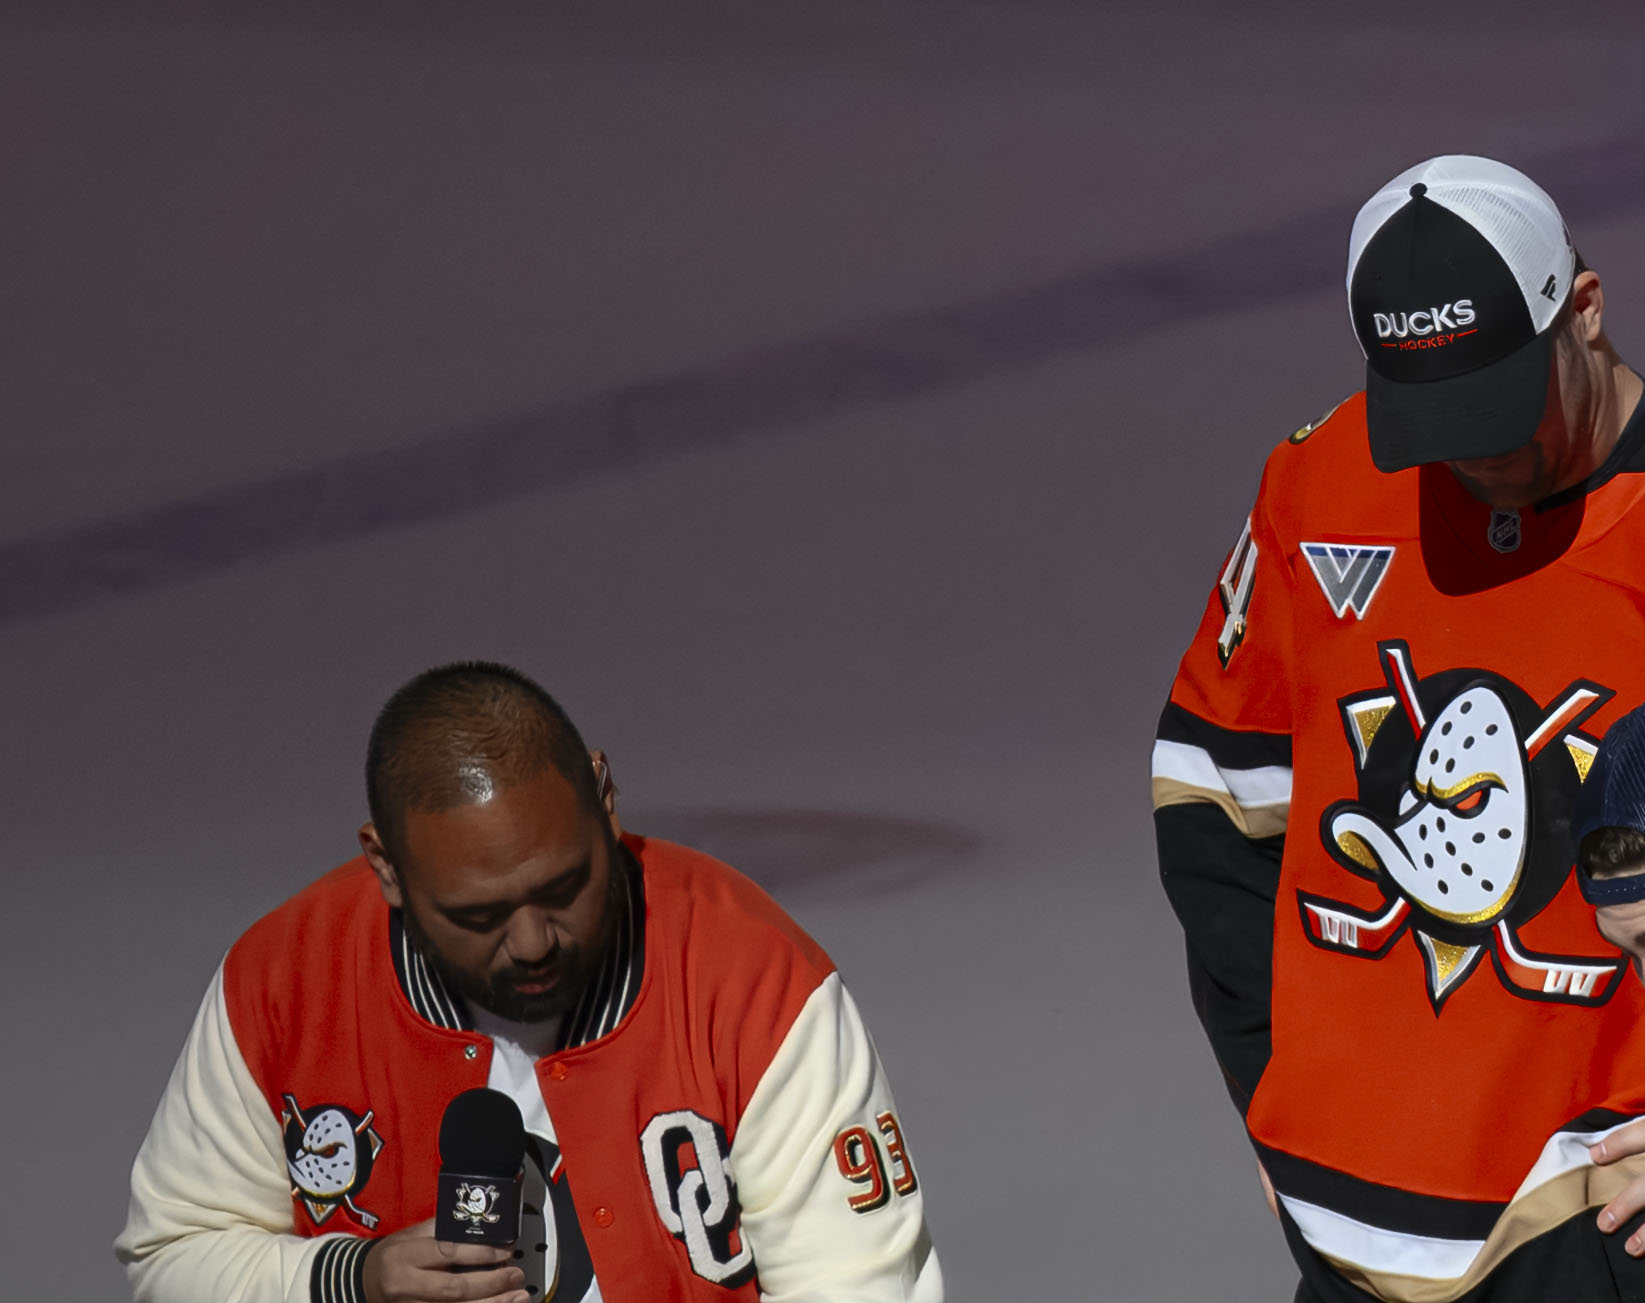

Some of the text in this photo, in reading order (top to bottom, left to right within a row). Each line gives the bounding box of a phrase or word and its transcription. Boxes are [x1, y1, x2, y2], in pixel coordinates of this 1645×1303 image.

[1373, 299, 1476, 338] DUCKS
[1399, 333, 1455, 351] HOCKEY
[833, 1110, 919, 1214] 93
